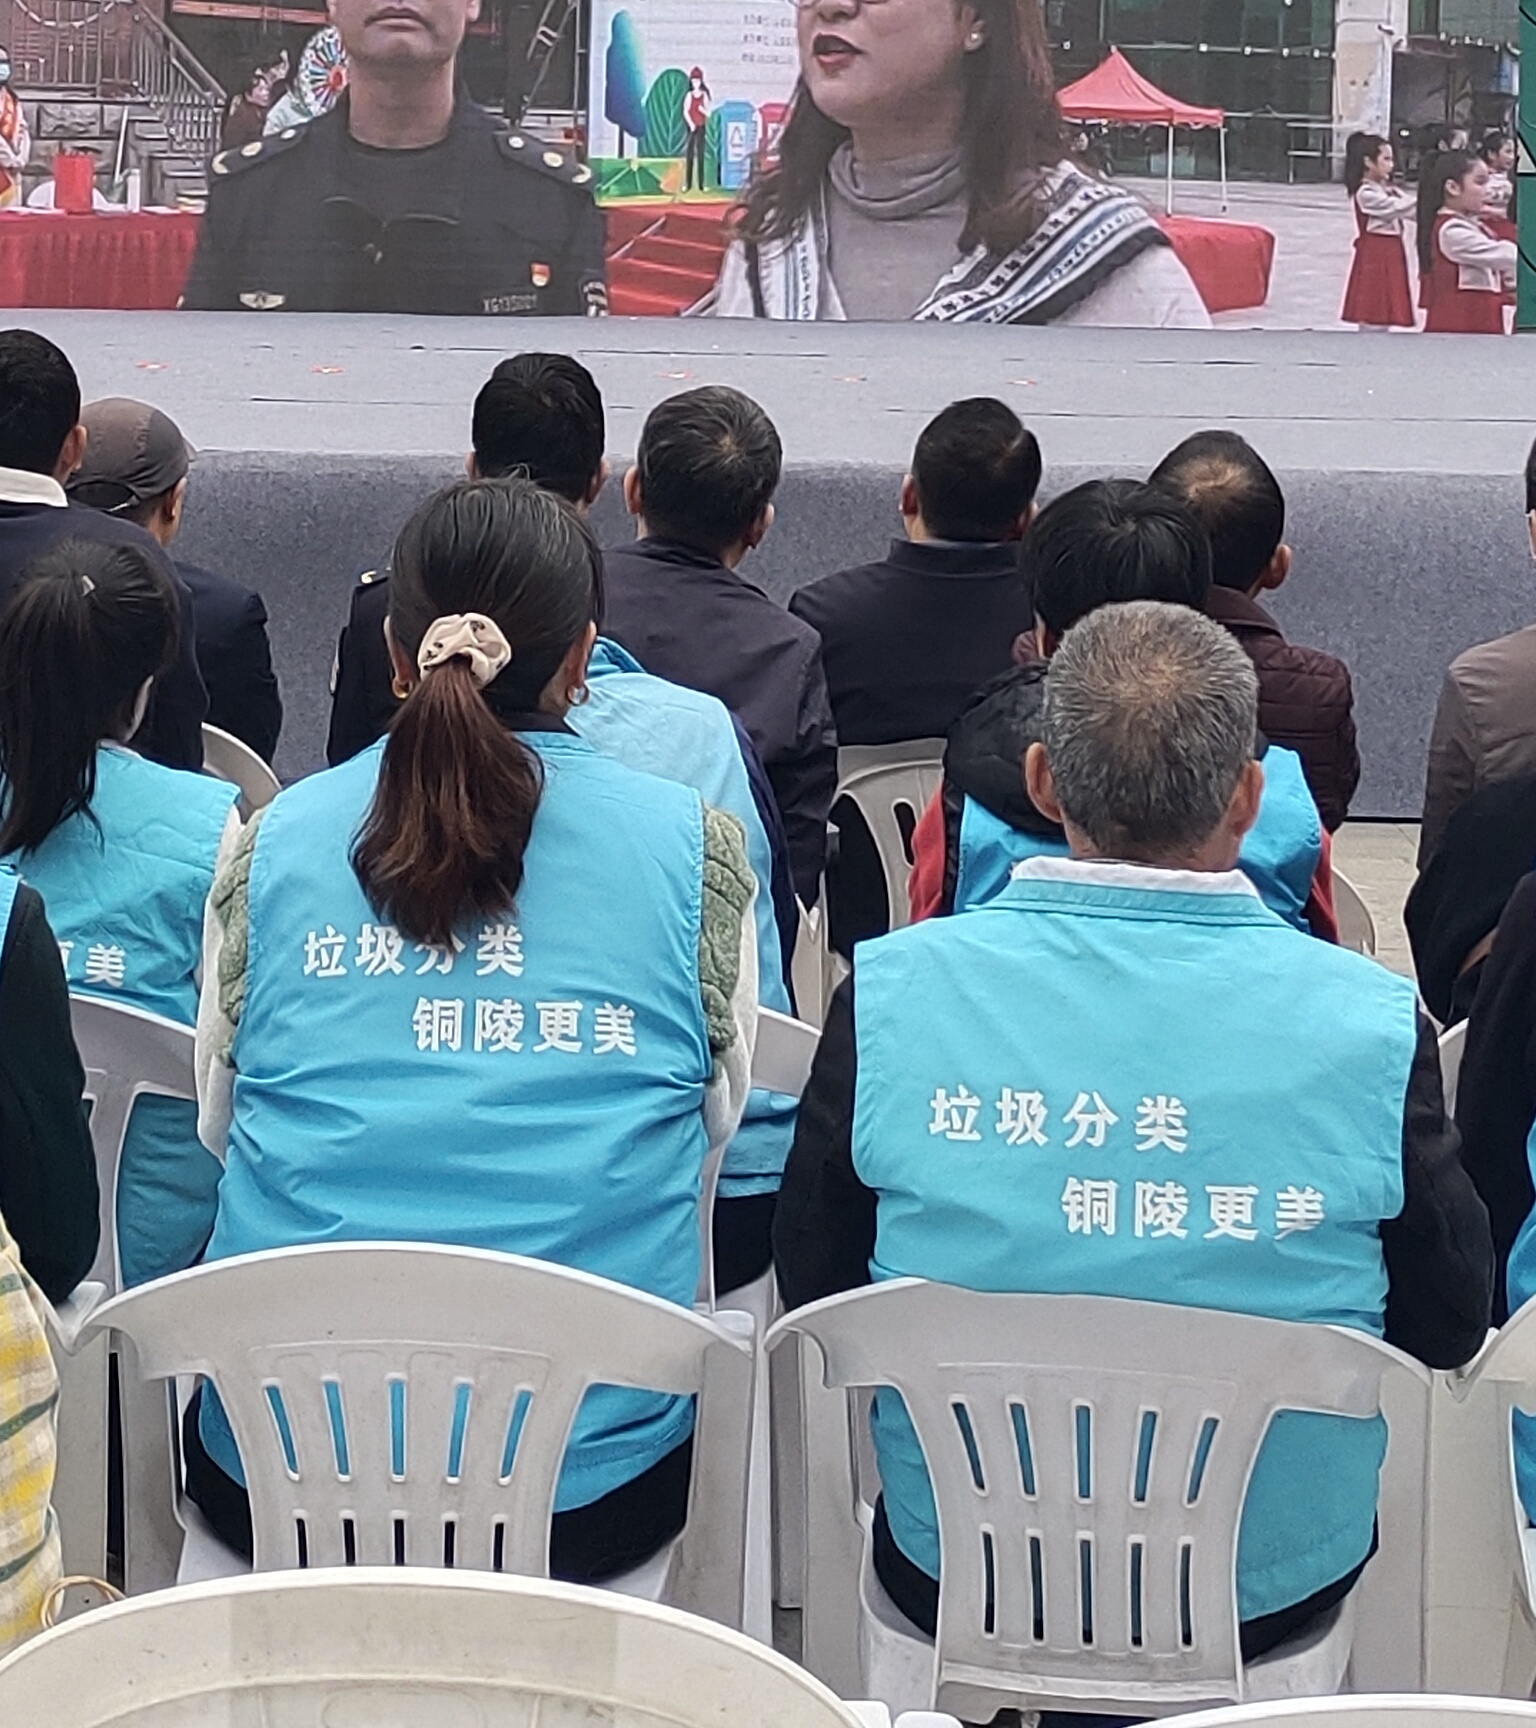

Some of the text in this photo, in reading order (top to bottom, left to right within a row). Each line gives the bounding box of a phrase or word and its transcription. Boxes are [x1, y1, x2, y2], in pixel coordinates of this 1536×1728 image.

[411, 995, 639, 1056] 铜陵更美
[929, 1084, 1189, 1154] 垃圾分类
[1061, 1176, 1326, 1242] 铜陵更美
